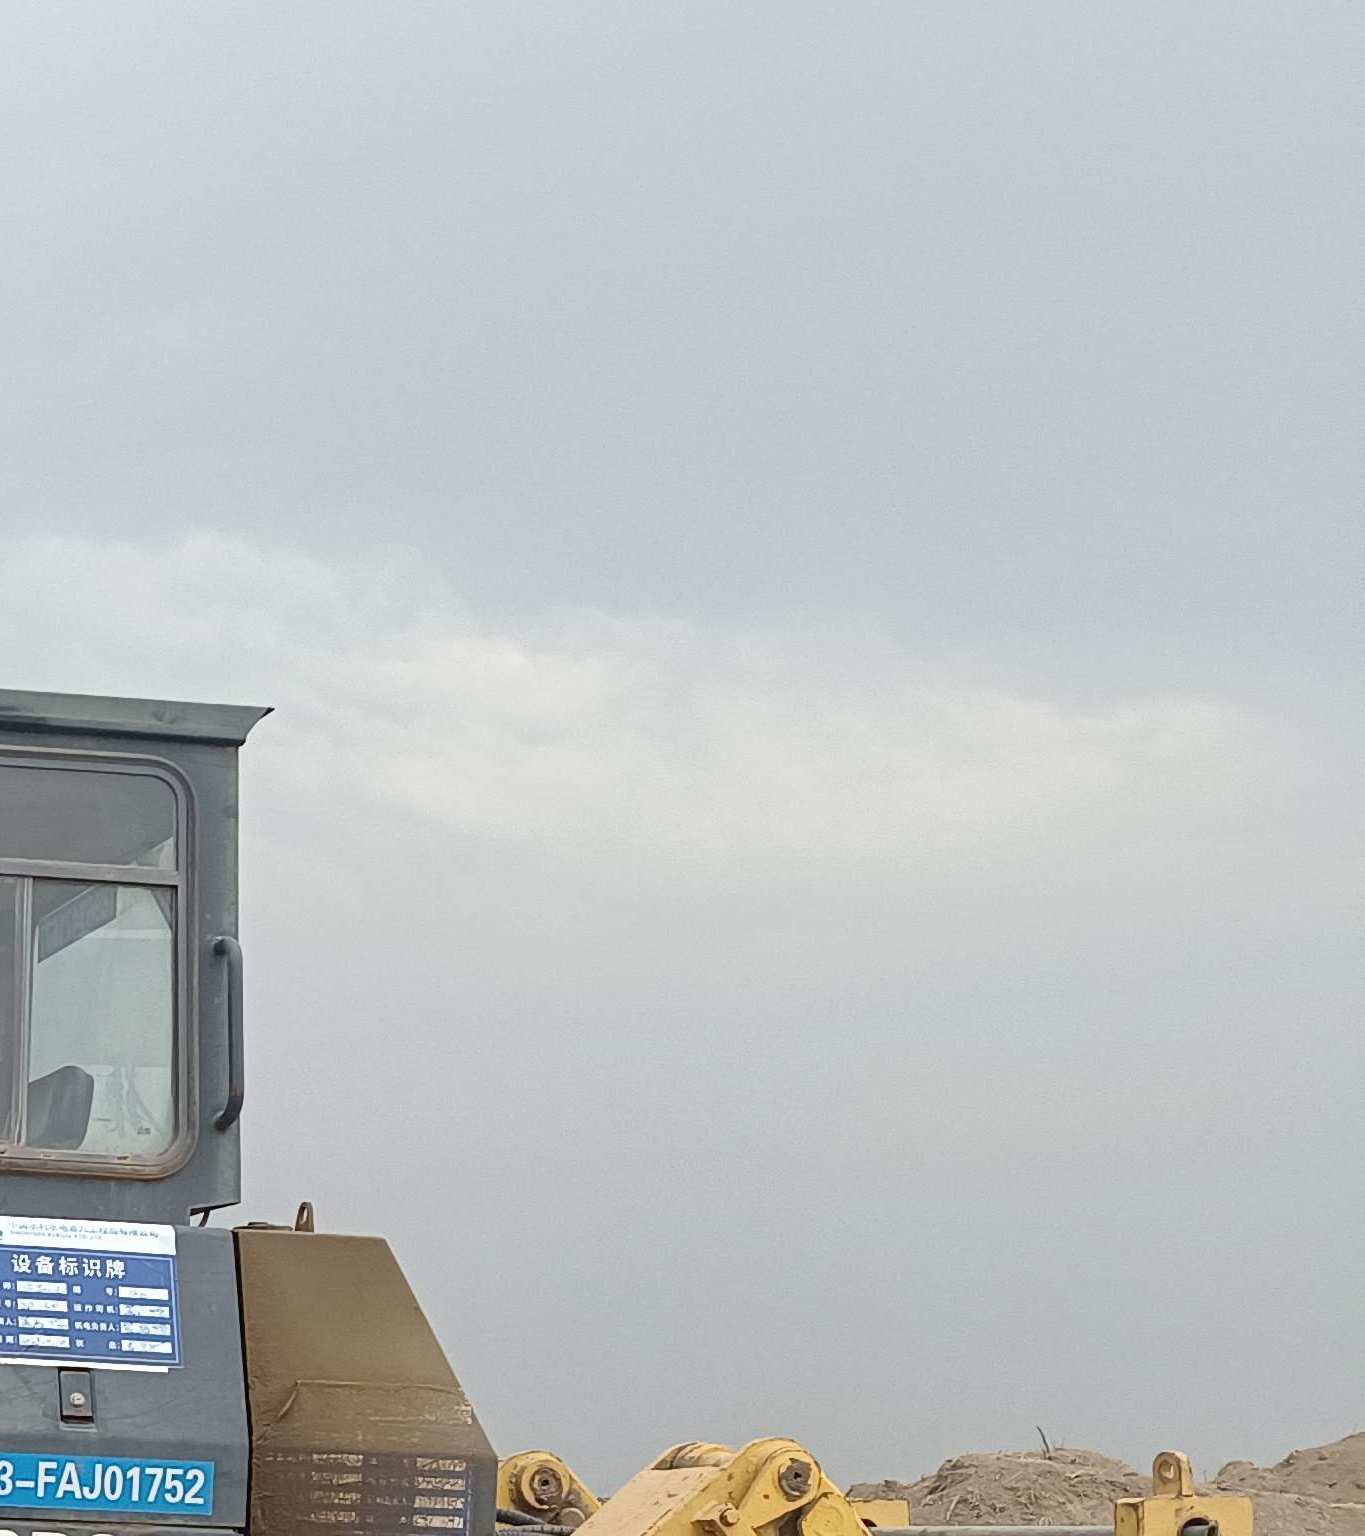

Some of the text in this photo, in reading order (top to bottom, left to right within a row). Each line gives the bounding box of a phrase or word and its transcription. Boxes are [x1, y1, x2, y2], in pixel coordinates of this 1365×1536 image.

[11, 1254, 126, 1279] 设备标识牌
